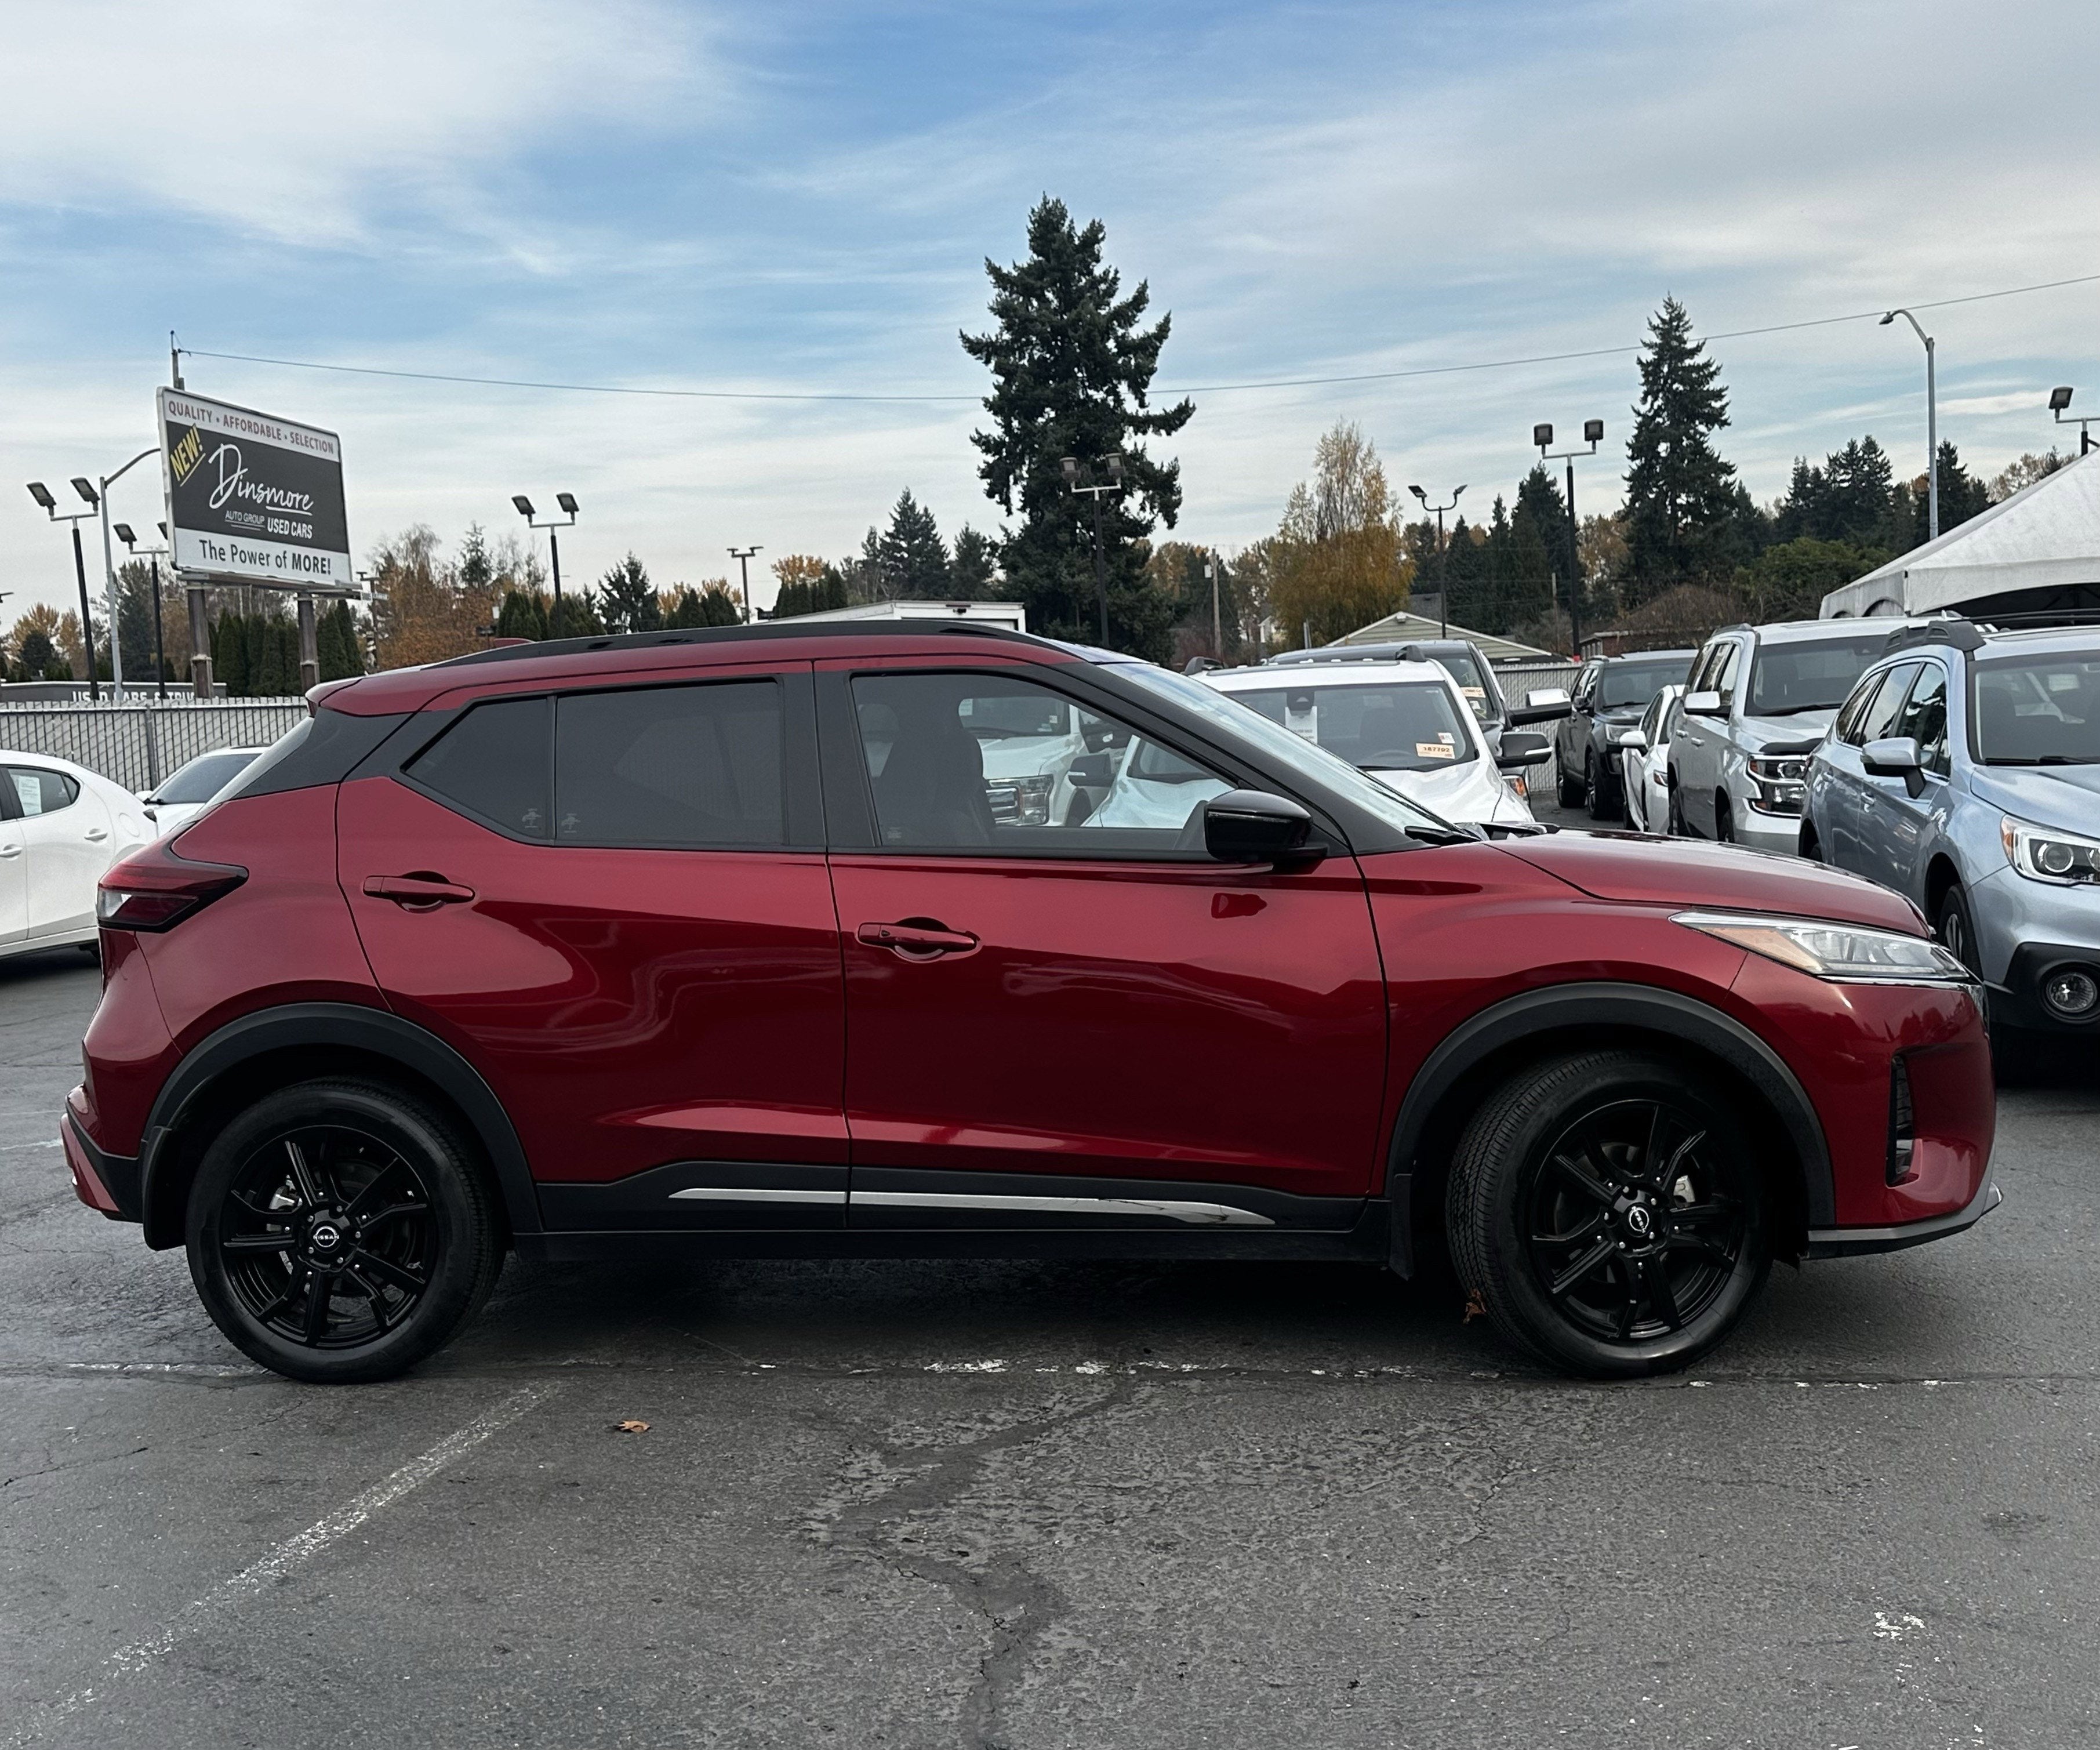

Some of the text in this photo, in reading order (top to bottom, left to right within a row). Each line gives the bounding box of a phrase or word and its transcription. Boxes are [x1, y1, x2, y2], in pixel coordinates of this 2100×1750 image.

[168, 400, 334, 454] QUALITY AFFORDABLE SELECTION
[170, 423, 204, 482] NEW!
[208, 444, 314, 510] Dinsmore
[225, 510, 313, 539] AUTO GROUP USED CARS
[199, 539, 331, 575] The Power of MORE!
[72, 691, 108, 702] USD
[113, 691, 148, 702] ARS
